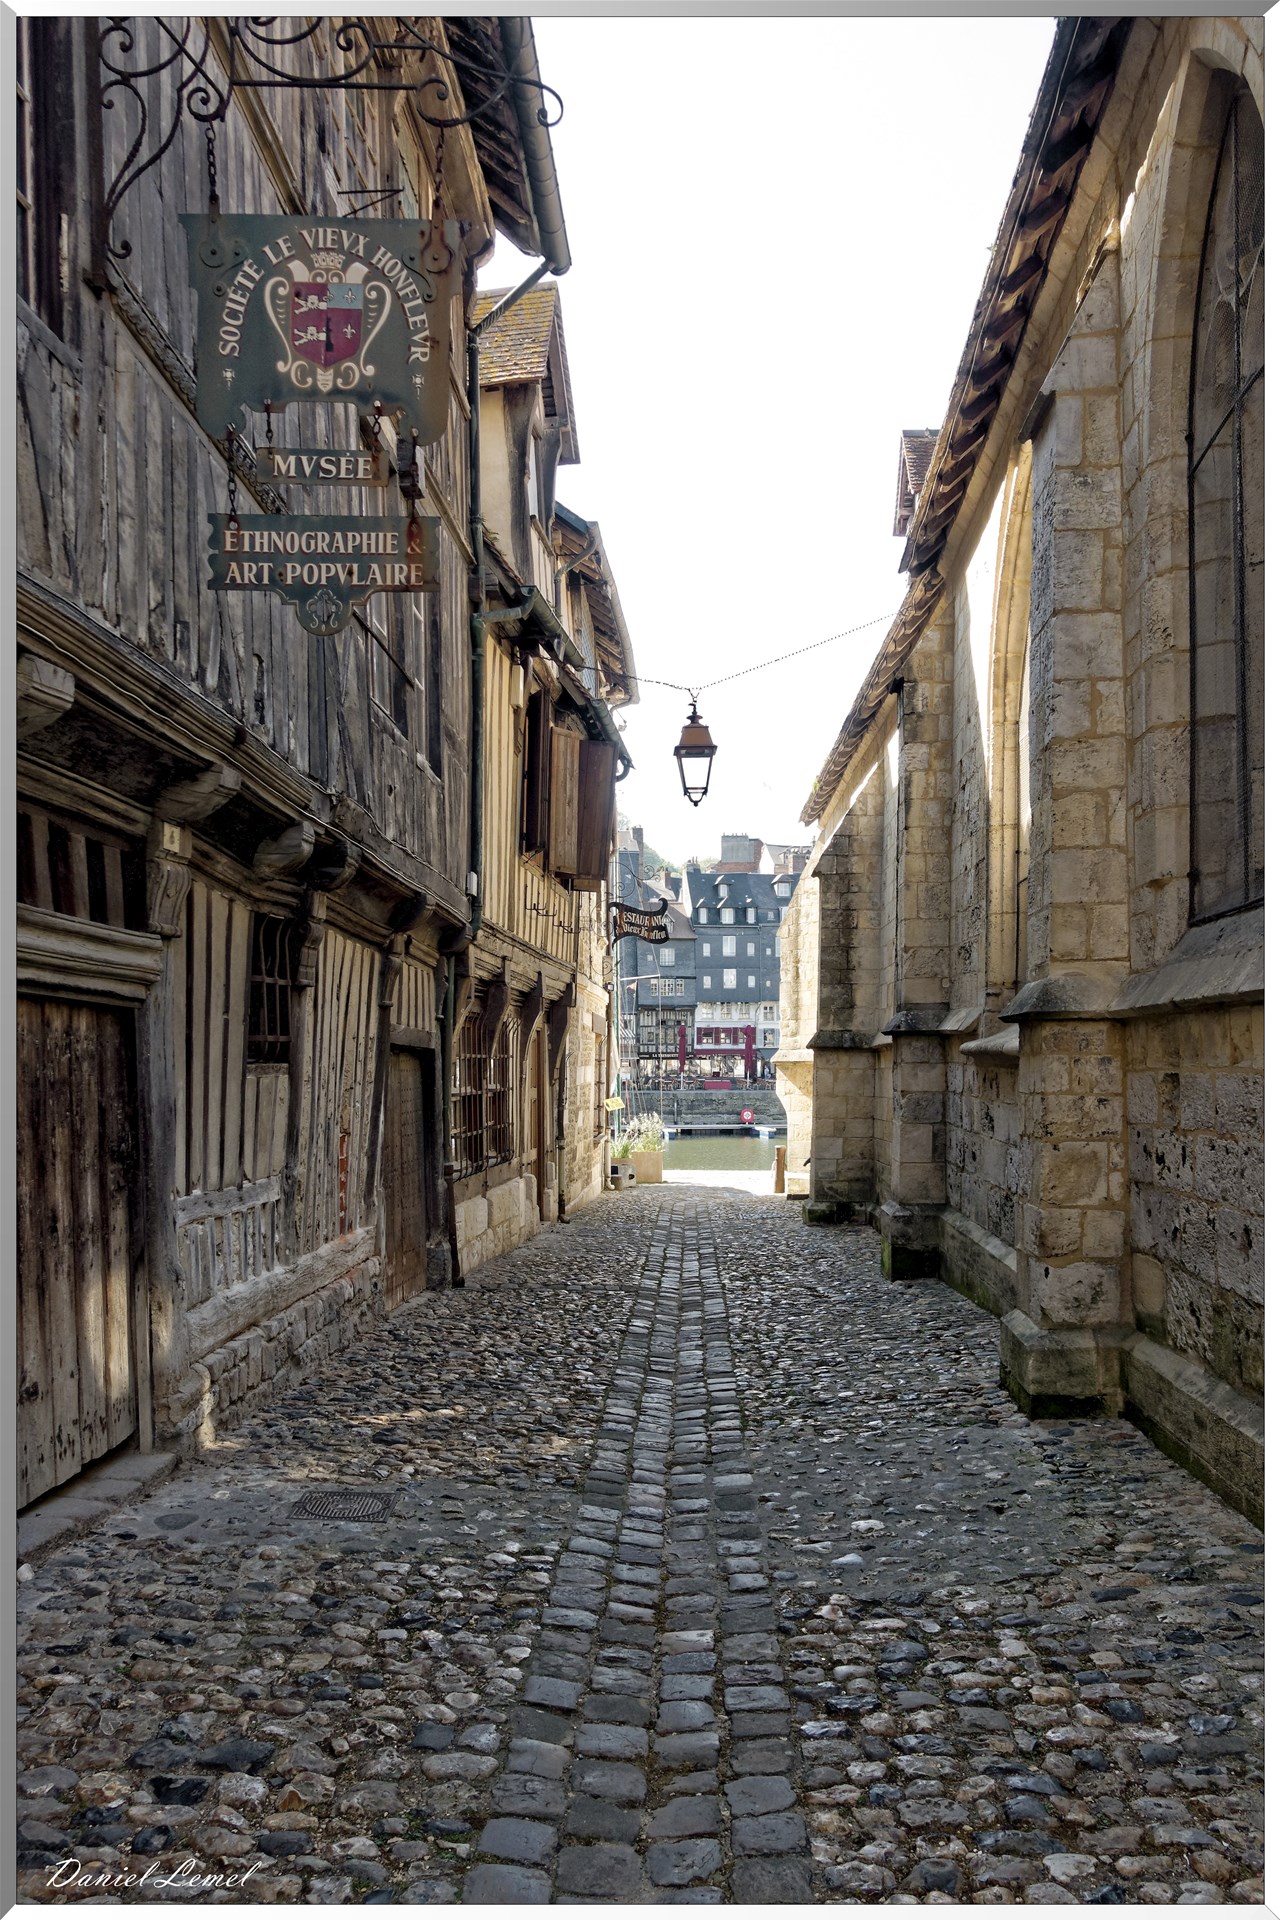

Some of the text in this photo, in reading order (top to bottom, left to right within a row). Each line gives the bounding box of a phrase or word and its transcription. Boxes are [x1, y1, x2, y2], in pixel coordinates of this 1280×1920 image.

[262, 235, 296, 267] LE
[299, 227, 370, 258] VIEVX
[369, 245, 431, 365] HONFLEVR
[224, 530, 423, 554] ETHNOGRAPHIE &
[224, 561, 424, 586] ART POPVLAIRE
